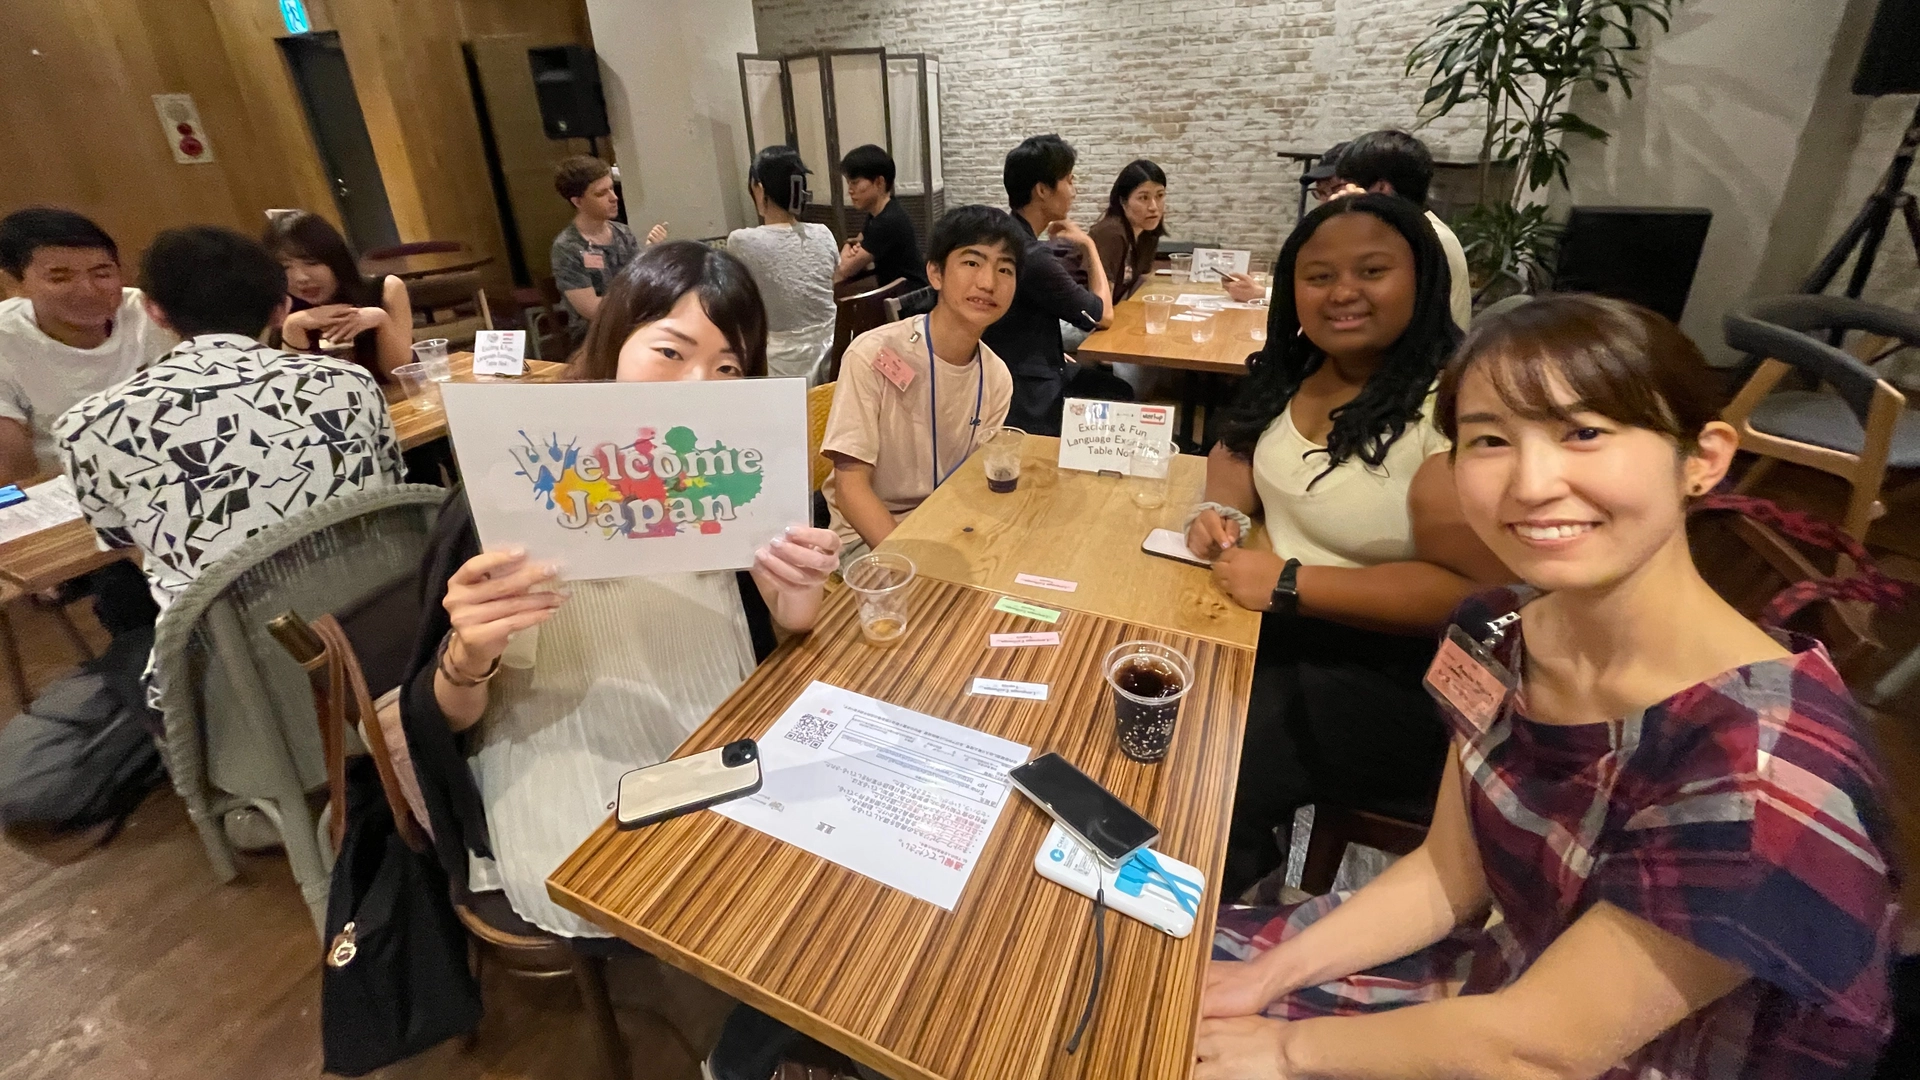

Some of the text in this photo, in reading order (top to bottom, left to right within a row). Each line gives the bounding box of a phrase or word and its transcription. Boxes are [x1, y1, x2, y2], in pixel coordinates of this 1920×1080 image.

[1118, 423, 1126, 432] &
[1129, 425, 1147, 437] Fun
[1067, 435, 1111, 447] Language
[1087, 446, 1112, 455] Table
[508, 442, 764, 483] Welcome
[556, 490, 737, 534] Japan
